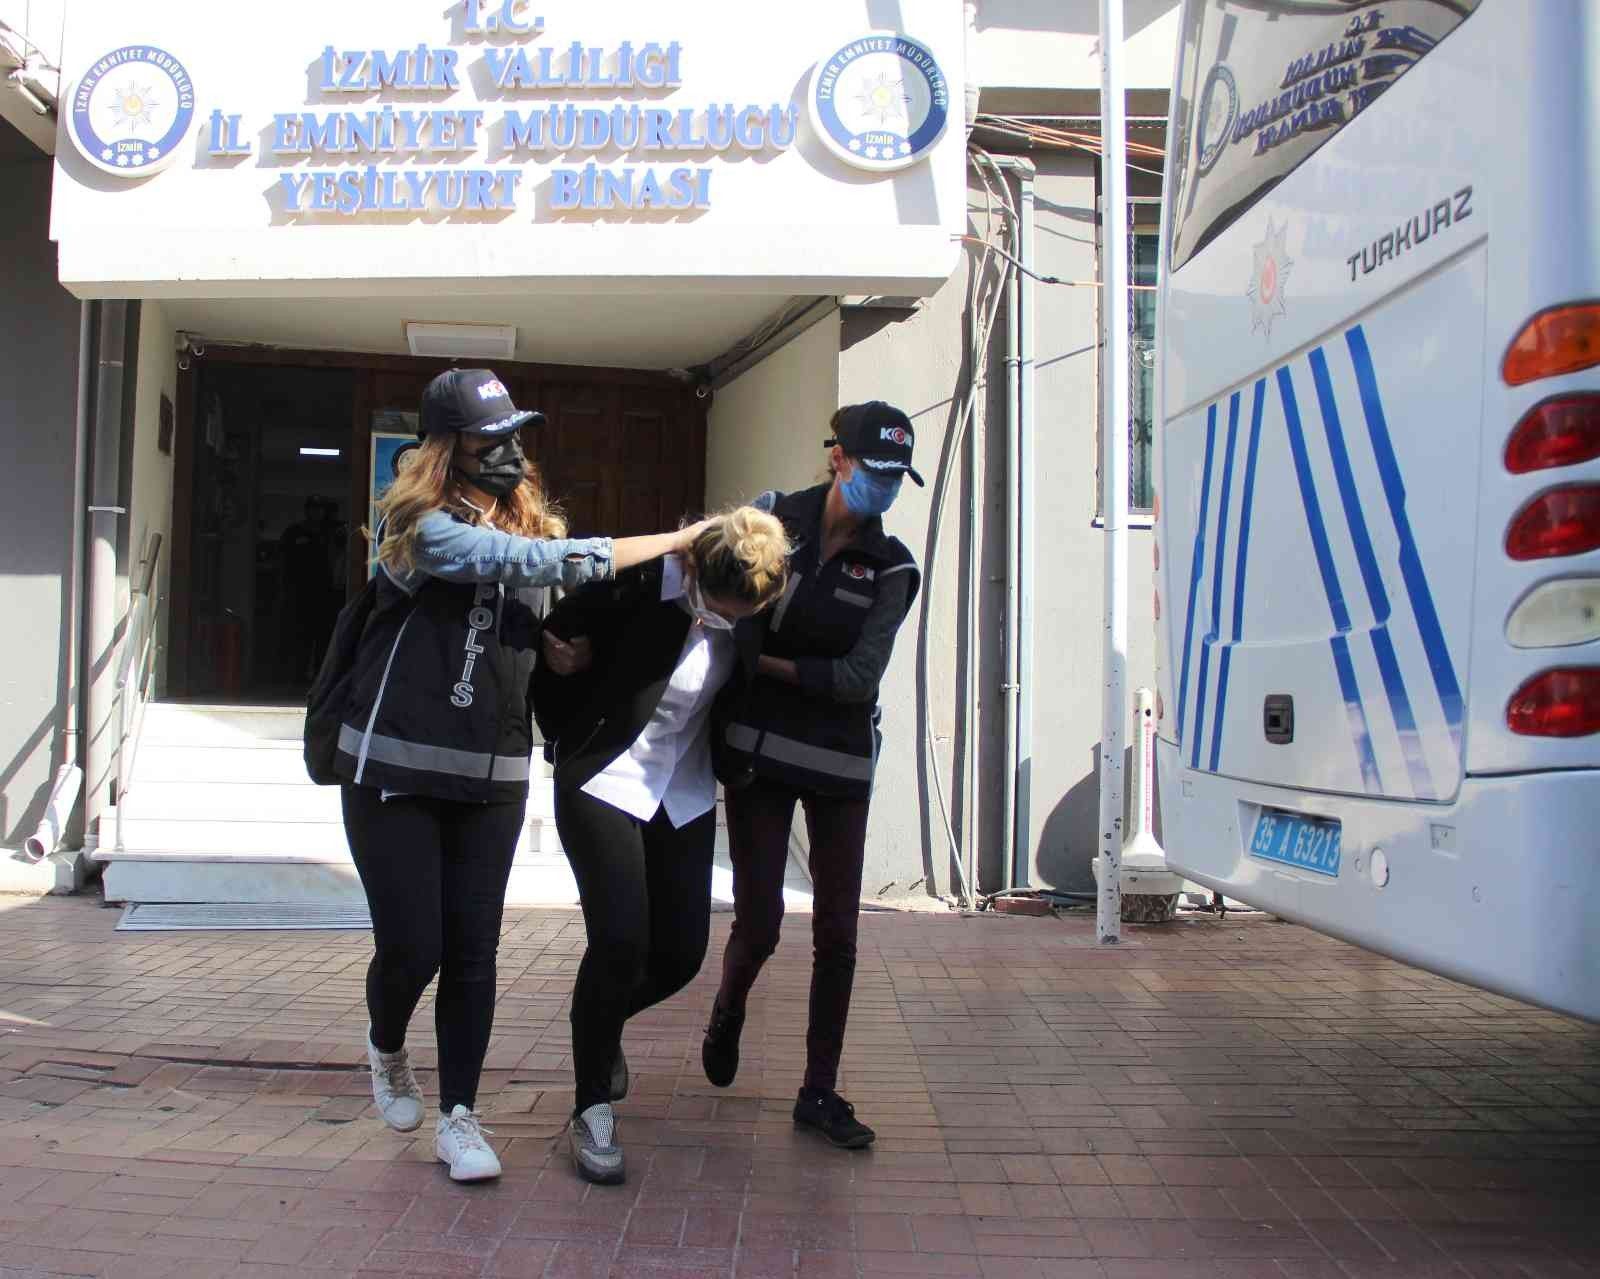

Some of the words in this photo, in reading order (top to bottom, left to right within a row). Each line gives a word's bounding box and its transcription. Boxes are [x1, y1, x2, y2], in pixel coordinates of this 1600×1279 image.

[320, 43, 460, 90] İZMİR
[208, 108, 251, 154] İL
[271, 104, 484, 153] EMNİYET
[279, 165, 523, 215] YEŞİLYURT
[551, 162, 713, 210] BİNASI
[1346, 184, 1473, 282] TURKUAZ
[450, 582, 494, 707] POLİS
[1256, 816, 1277, 852] 35
[1279, 821, 1293, 856] A
[1294, 824, 1341, 868] 63213
